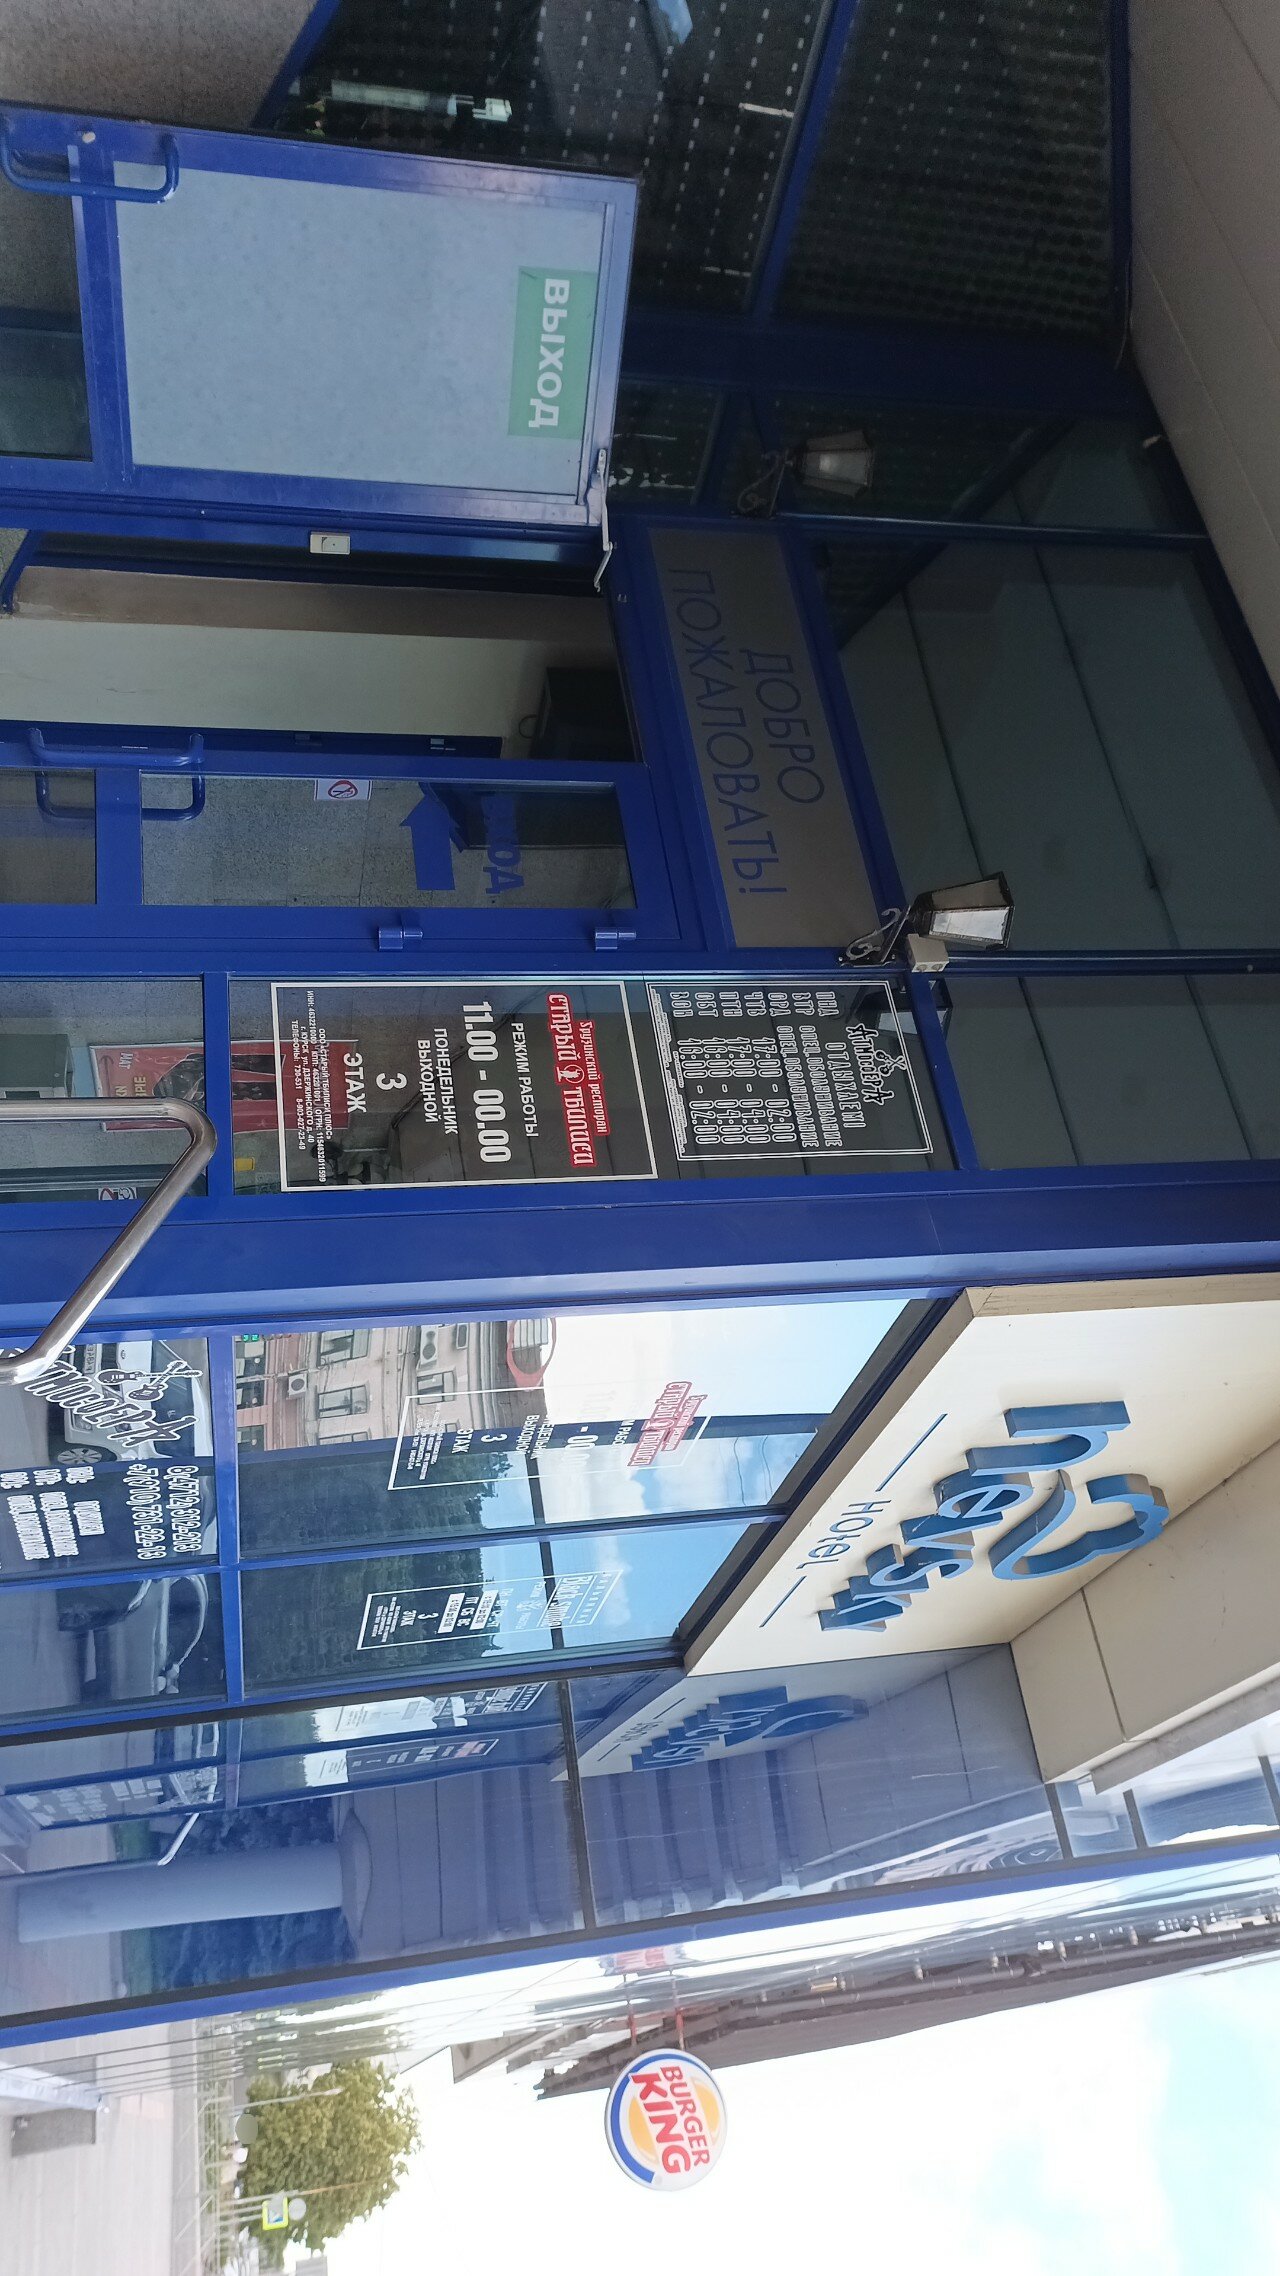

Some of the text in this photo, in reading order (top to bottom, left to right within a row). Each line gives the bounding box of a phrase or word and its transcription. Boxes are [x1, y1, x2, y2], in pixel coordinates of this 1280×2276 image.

[528, 278, 573, 429] ВЫХОД
[668, 567, 788, 895] ПОЖАЛОВАТЬ!
[740, 648, 825, 804] ДОБРО
[718, 991, 742, 1016] ПТН
[743, 991, 766, 1016] ЧТВ
[792, 992, 815, 1016] ВТР
[300, 1032, 309, 1054] КУРСК
[462, 1001, 499, 1061] 11.00
[301, 1056, 310, 1067] ул.
[307, 991, 315, 1007] ИНН:
[311, 1051, 319, 1067] КПП:
[315, 1109, 323, 1130] ОГРН:
[318, 1028, 326, 1044] ООО
[322, 1079, 331, 1113] ТБИЛИСИ
[548, 993, 595, 1165] СТАРЫЙ ТБИЛИСИ
[677, 1038, 708, 1078] 16:00
[701, 1036, 732, 1078] 16:00
[726, 1036, 757, 1078] 17:00
[752, 1037, 782, 1078] 17:00
[291, 1020, 306, 1150] ТЕЛЕФОНЫ: 730-531 8-903-027-23-49
[303, 1068, 314, 1125] ДЗЕРЖИНСКОГО
[342, 1052, 367, 1113] ЭТАЖ
[375, 1072, 408, 1091] 3
[417, 1039, 442, 1122] ВЫХОДНОЙ
[432, 1028, 458, 1134] ПОНЕДЕЛЬНИК
[511, 1022, 539, 1138] РЕЖИМ РАБОТЫ
[472, 1089, 512, 1163] 00.00
[588, 1083, 608, 1133] ресторан
[689, 1100, 720, 1145] 02:00
[714, 1099, 746, 1144] 04:00
[739, 1098, 770, 1144] 04:00
[764, 1098, 797, 1142] 02:00
[307, 1134, 315, 1143] 40
[450, 1428, 475, 1455] ЭТАЖ
[480, 1433, 509, 1443] 3
[515, 1415, 539, 1455] ВЫХОДНОЙ
[400, 1610, 417, 1626] ЭТАЖ
[630, 2072, 691, 2174] KING
[660, 2066, 711, 2167] BURGER
